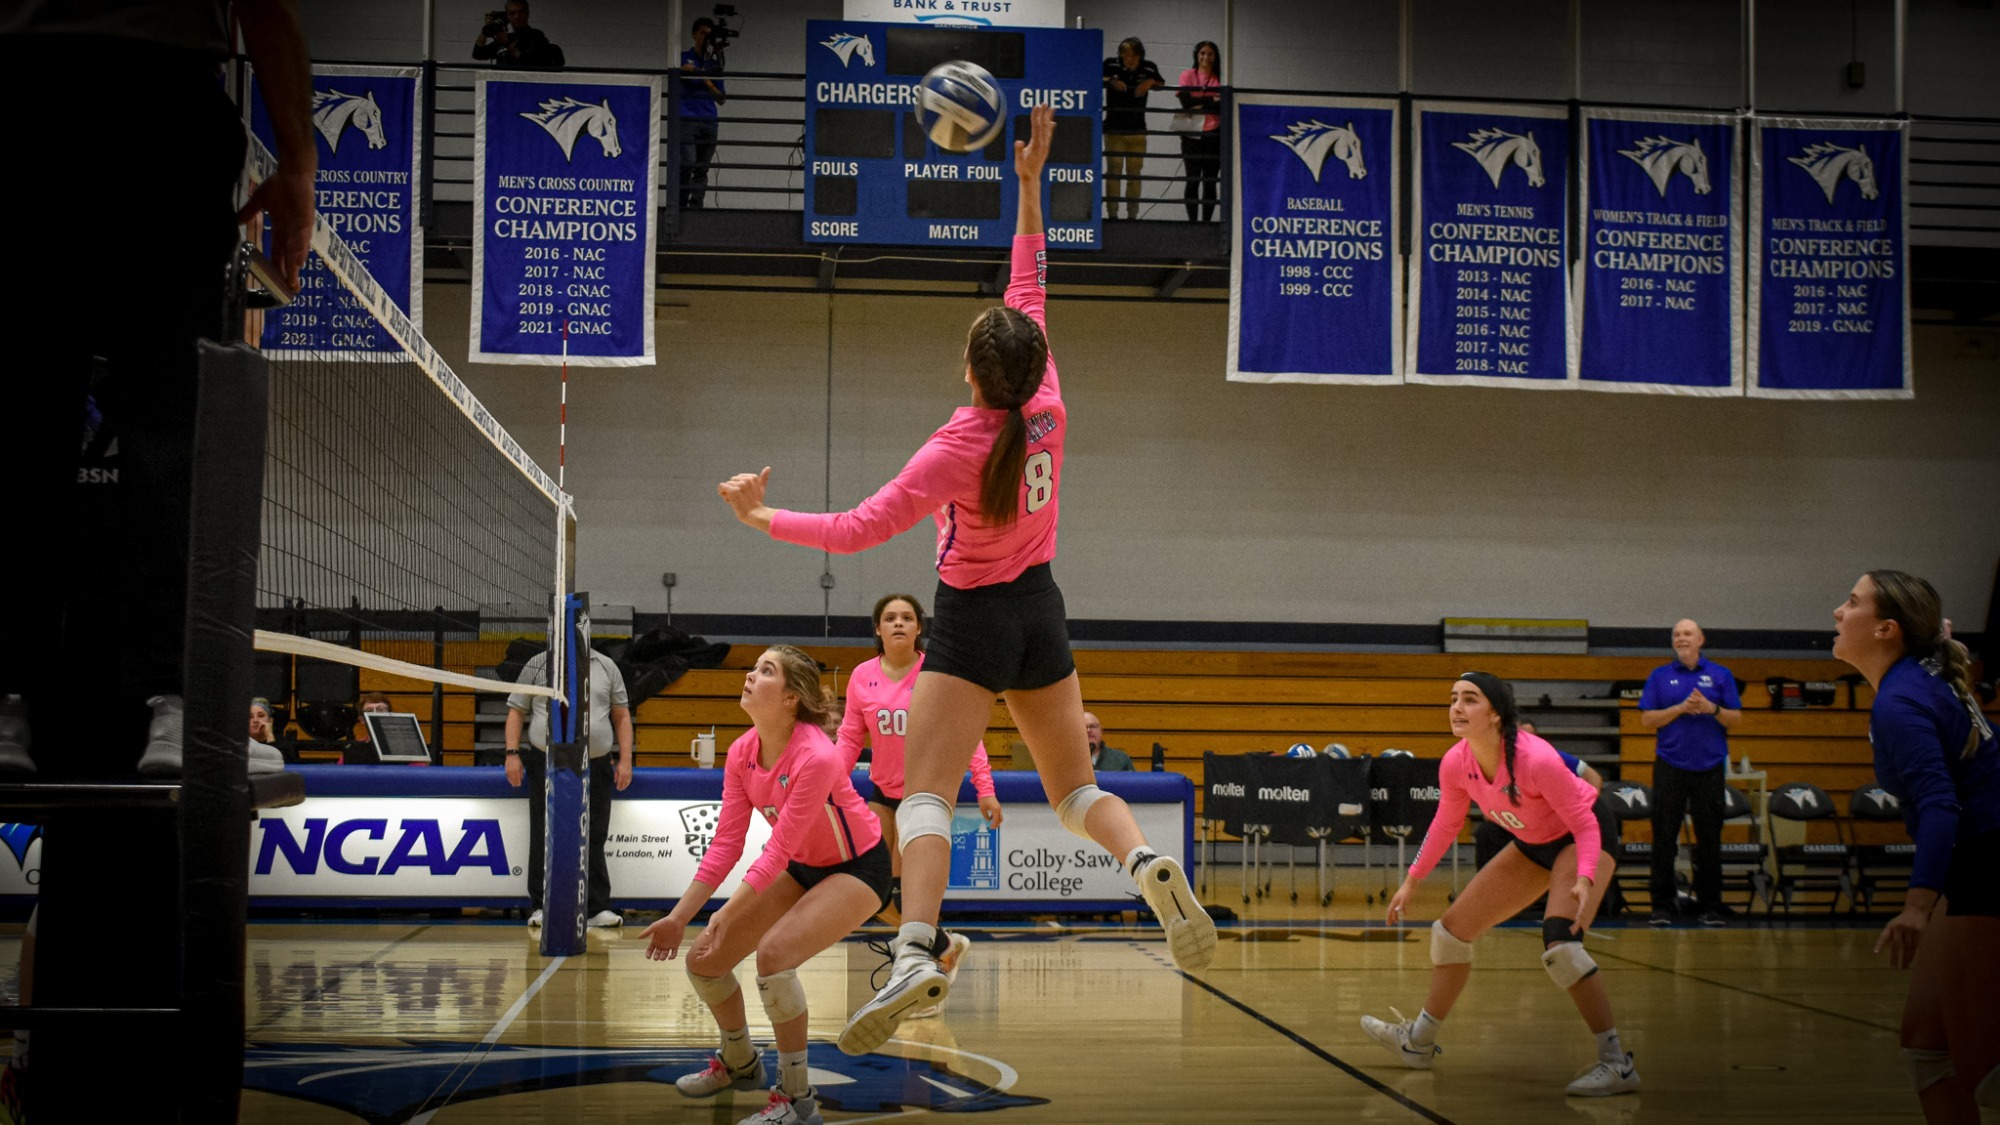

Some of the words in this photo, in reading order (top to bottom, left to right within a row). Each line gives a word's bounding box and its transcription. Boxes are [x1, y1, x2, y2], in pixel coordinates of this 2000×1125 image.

[892, 0, 938, 11] BANK
[943, 0, 956, 11] &
[960, 0, 1012, 14] TRUST
[815, 83, 923, 106] CHARGERS
[1019, 88, 1088, 110] GUEST
[315, 168, 351, 183] CROSS
[353, 170, 409, 185] COUNTRY
[812, 161, 859, 176] FOULS
[904, 163, 959, 179] PLAYER
[967, 165, 1003, 180] FOUL
[1048, 168, 1094, 183] FOULS
[498, 175, 536, 190] MEN'S
[538, 177, 577, 191] CROSS
[578, 178, 635, 193] COUNTRY
[317, 189, 402, 210] ERENCE
[495, 195, 637, 217] CONFERENCE
[1287, 197, 1344, 212] BASEBALL
[1456, 203, 1492, 217] MEN'S
[1492, 204, 1534, 220] TENNIS
[1593, 209, 1645, 224] WOMEN'S
[1646, 212, 1683, 226] TRACK
[1684, 213, 1694, 227] &
[1696, 214, 1728, 228] FIELD
[321, 211, 402, 234] PIONS
[494, 218, 637, 242] CHAMPIONS
[811, 221, 859, 237] SCORE
[1251, 216, 1383, 237] CONFERENCE
[1771, 217, 1806, 231] MEN'S
[1807, 218, 1843, 232] TRACK
[1845, 219, 1854, 233] &
[1856, 219, 1886, 233] FIELD
[929, 224, 979, 240] MATCH
[1047, 227, 1094, 243] SCORE
[1429, 222, 1560, 245] CONFERENCE
[1595, 228, 1724, 252] CONFERENCE
[524, 246, 560, 260] 2016
[573, 247, 606, 262] NAC
[1250, 238, 1383, 261] CHAMPIONS
[1770, 237, 1893, 257] CONFERENCE
[1429, 243, 1561, 268] CHAMPIONS
[1594, 249, 1725, 274] CHAMPIONS
[524, 265, 559, 278] 2017
[573, 265, 605, 280] NAC
[1280, 265, 1312, 278] 1998
[1322, 265, 1353, 280] CCC
[1770, 258, 1895, 279] CHAMPIONS
[299, 275, 325, 290] 016
[1456, 269, 1489, 283] 2013
[1500, 270, 1532, 285] NAC
[1620, 277, 1654, 291] 2016
[1665, 278, 1696, 293] NAC
[518, 283, 554, 297] 2018
[566, 283, 611, 298] GNAC
[1279, 282, 1312, 296] 1999
[1322, 283, 1353, 297] CCC
[1456, 287, 1489, 301] 2014
[1500, 288, 1532, 303] NAC
[1793, 284, 1826, 298] 2016
[1837, 284, 1867, 298] NAC
[519, 301, 554, 315] 2019
[567, 302, 611, 317] GNAC
[1620, 294, 1653, 308] 2017
[1664, 296, 1695, 311] NAC
[1793, 301, 1825, 315] 2017
[1837, 301, 1867, 315] NAC
[281, 312, 319, 328] 2019
[331, 313, 376, 330] GNAC
[1456, 305, 1490, 318] 2015
[1499, 306, 1531, 321] NAC
[518, 320, 553, 334] 2021
[566, 320, 612, 335] GNAC
[1455, 323, 1489, 336] 2016
[1499, 324, 1531, 339] NAC
[1788, 319, 1822, 333] 2019
[1832, 319, 1873, 333] GNAC
[280, 331, 316, 346] 2021
[331, 332, 376, 349] GNAC
[1455, 340, 1488, 354] 2017
[1498, 341, 1529, 356] NAC
[1455, 358, 1489, 371] 2018
[1497, 359, 1529, 374] NAC
[76, 467, 119, 484] BSN
[1025, 450, 1053, 515] 8
[877, 708, 908, 736] 20
[1258, 785, 1310, 802] molten
[1410, 785, 1441, 801] molte
[615, 834, 638, 843] Main
[641, 834, 669, 843] Street
[254, 818, 511, 876] NCAA
[616, 849, 655, 859] London,
[657, 849, 672, 858] NH
[1803, 845, 1847, 853] CHARGERS
[1008, 872, 1083, 896] College
